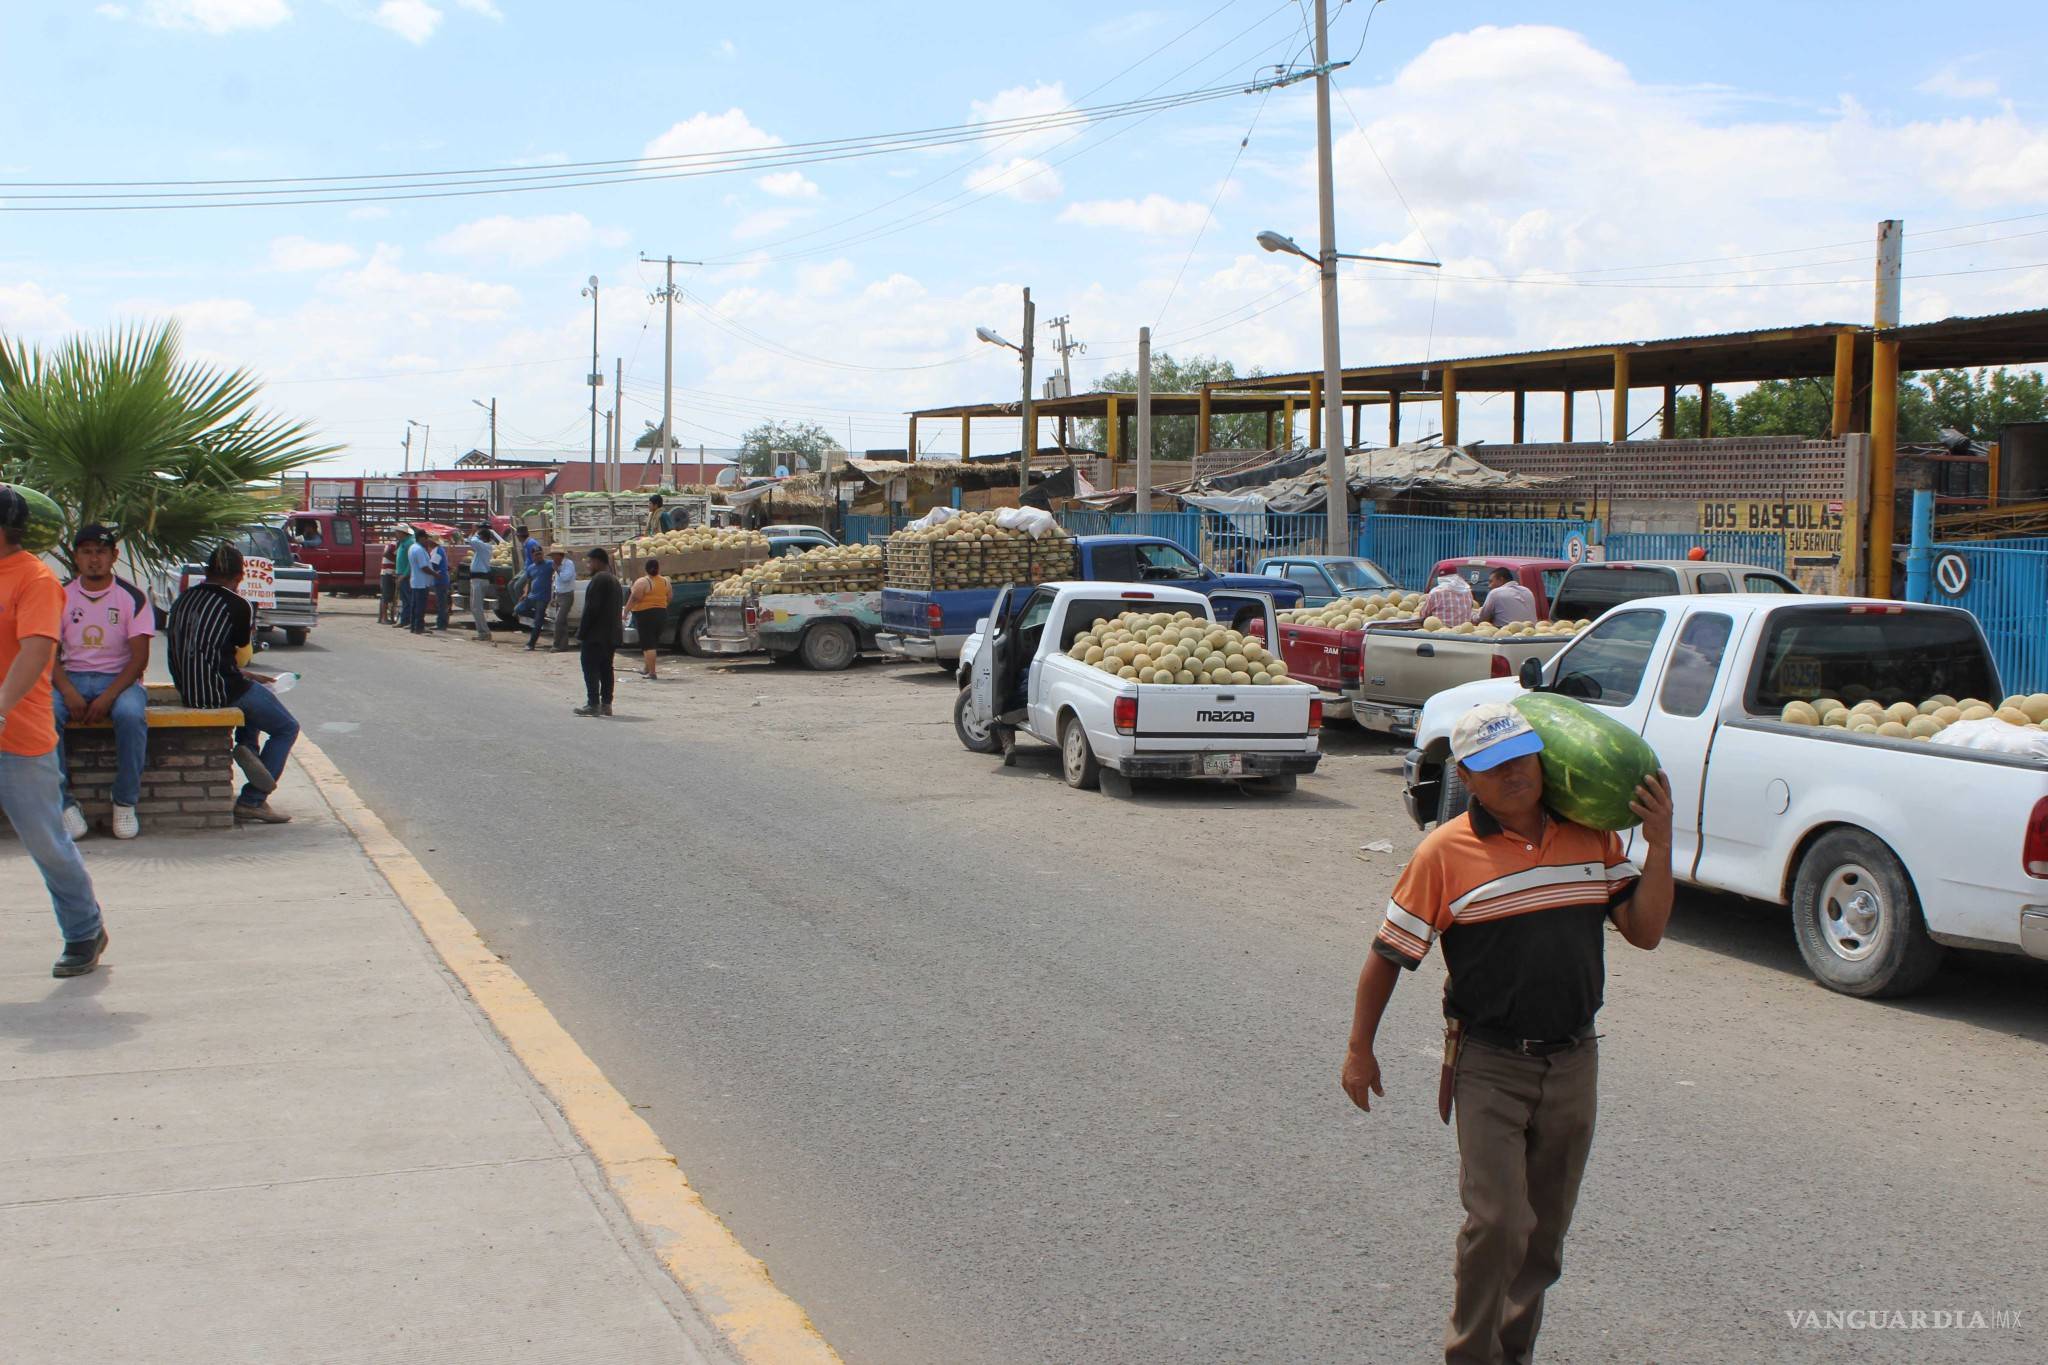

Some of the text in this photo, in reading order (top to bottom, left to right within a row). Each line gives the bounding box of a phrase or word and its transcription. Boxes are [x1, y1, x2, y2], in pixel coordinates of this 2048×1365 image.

[1704, 504, 1842, 530] DOS BASCULAS
[1790, 531, 1801, 550] SU
[1804, 532, 1841, 552] SERVICIO
[1323, 646, 1339, 655] RAM
